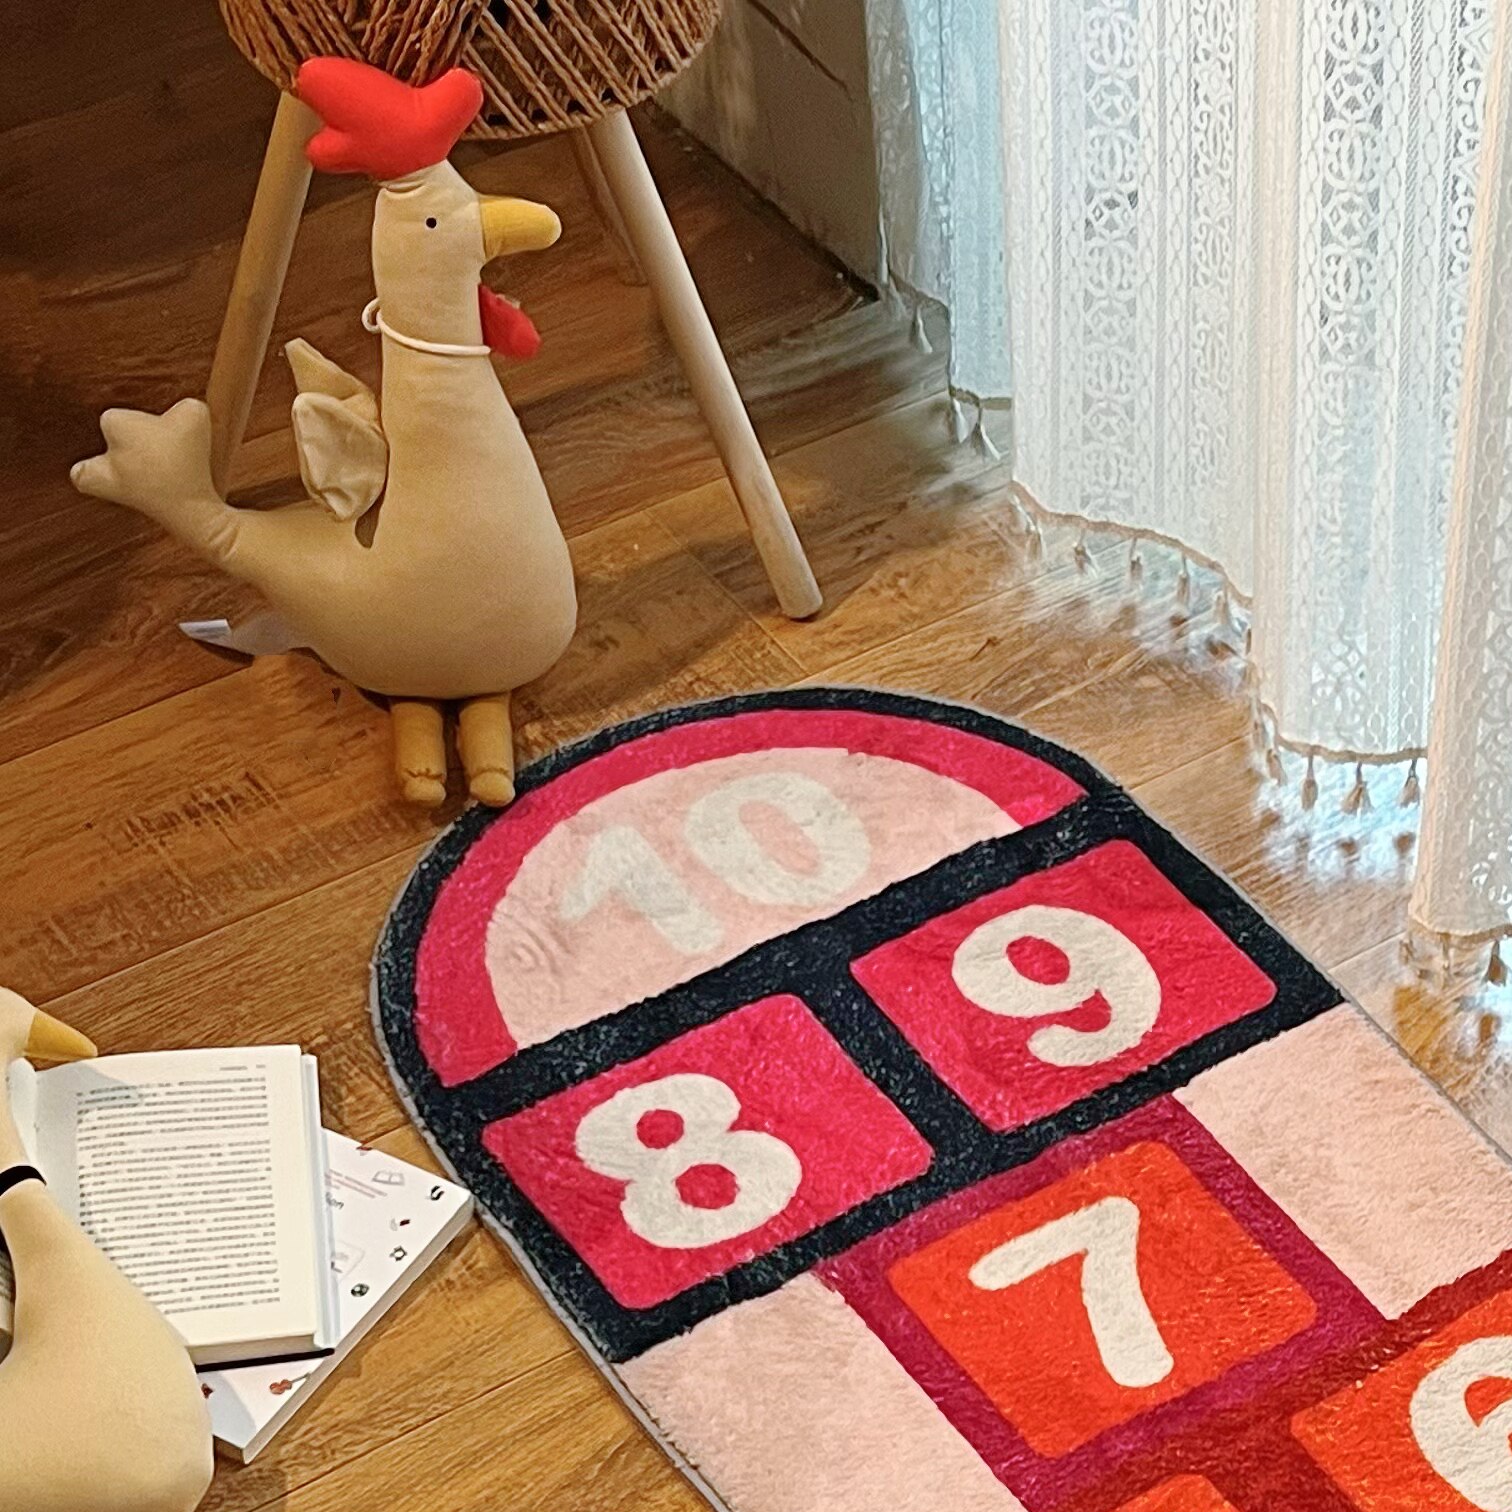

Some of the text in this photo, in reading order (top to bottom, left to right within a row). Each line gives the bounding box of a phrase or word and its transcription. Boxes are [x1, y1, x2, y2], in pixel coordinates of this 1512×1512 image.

[558, 770, 872, 956] 10
[952, 905, 1162, 1067] 9
[575, 1073, 802, 1249] 8
[969, 1196, 1174, 1388] 7
